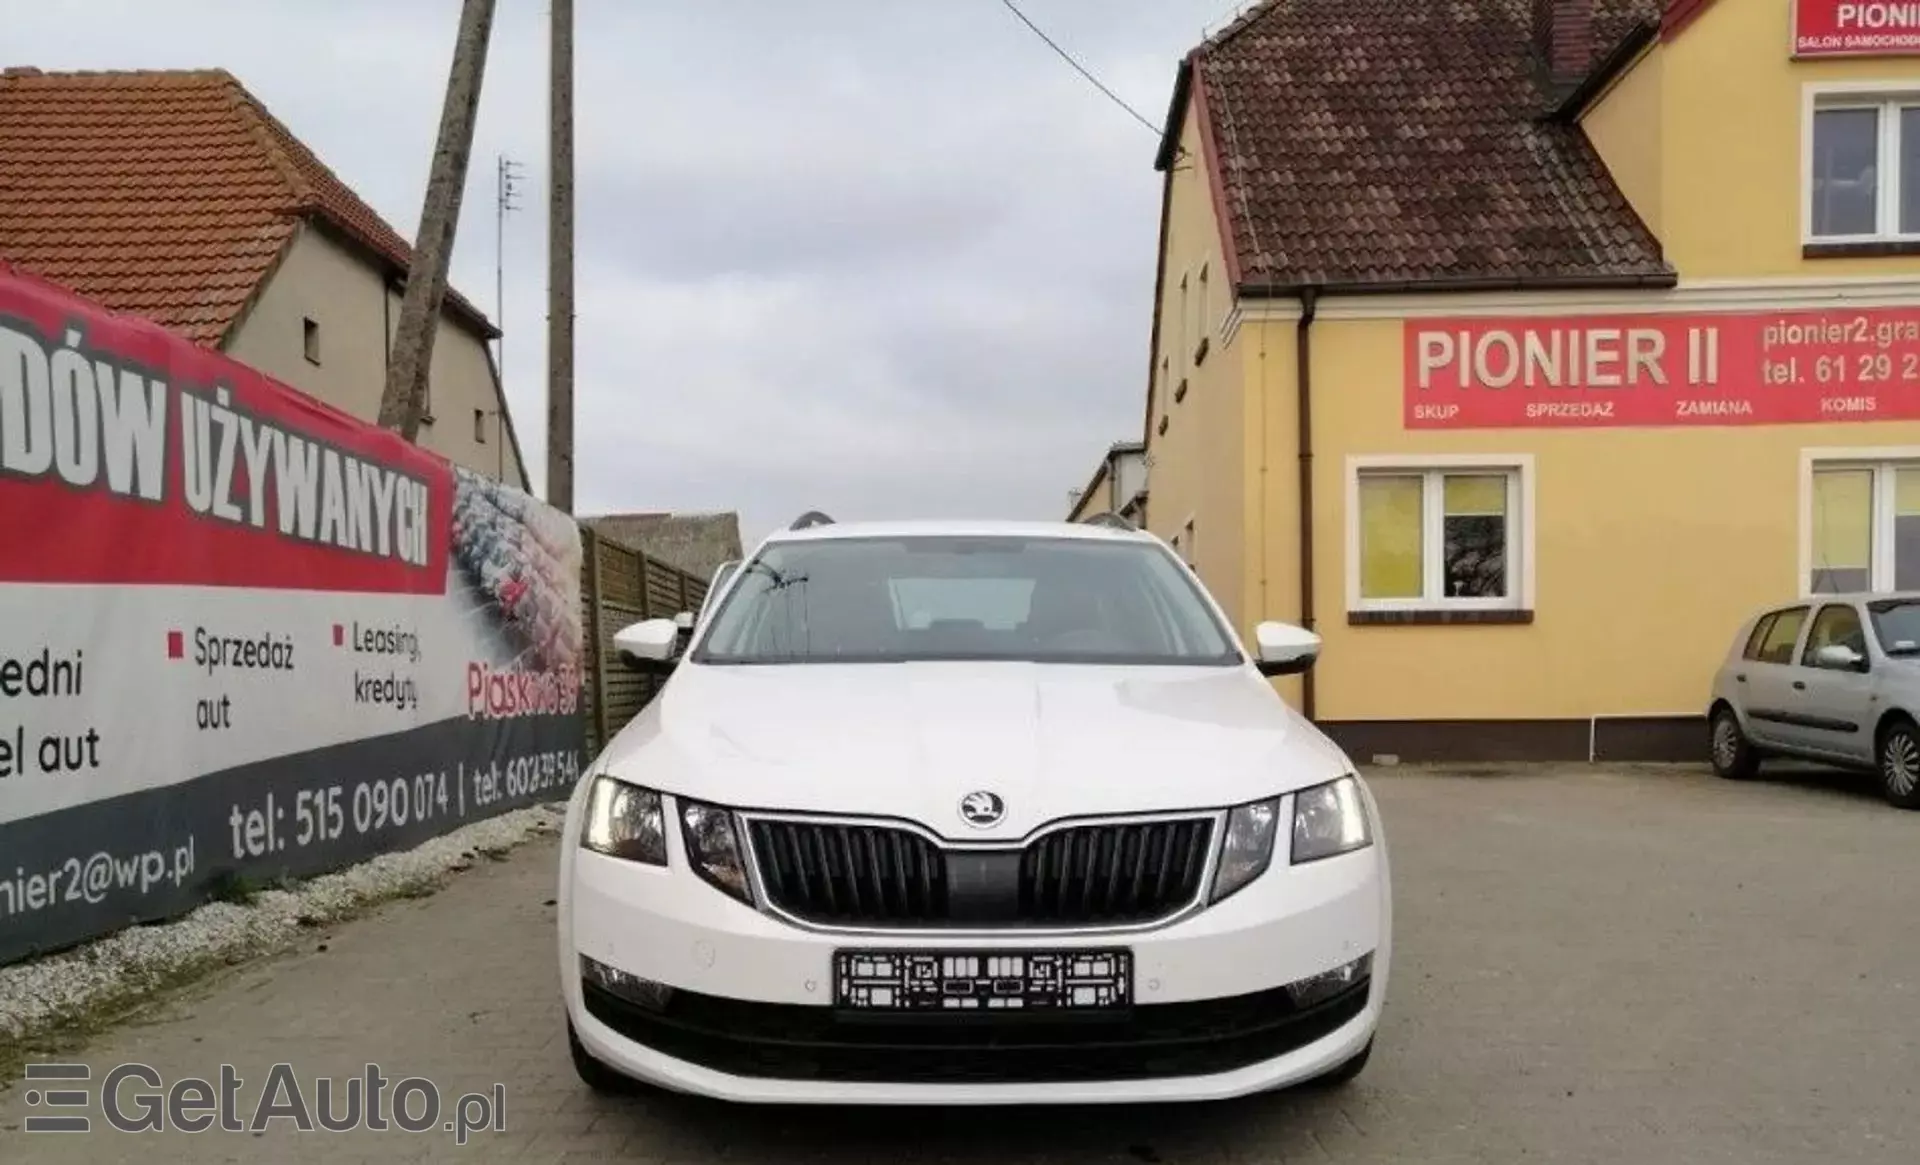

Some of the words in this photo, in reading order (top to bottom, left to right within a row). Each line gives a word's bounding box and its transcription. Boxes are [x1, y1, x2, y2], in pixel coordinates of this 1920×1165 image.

[1837, 3, 1920, 28] PIONI
[1798, 35, 1842, 48] SALON
[1763, 315, 1920, 352] pionier2.gra
[1418, 328, 1669, 389] PIONIER
[1688, 326, 1719, 385] II
[1762, 355, 1805, 385] tel.
[1815, 354, 1846, 383] 61
[1857, 353, 1892, 382] 29
[1901, 352, 1919, 380] 2
[1414, 404, 1460, 419] SKUP
[1676, 400, 1753, 416] ZAMIANA
[1820, 396, 1877, 412] KOMIS
[0, 326, 167, 501] DÓW
[181, 385, 428, 566] UŻYWANYCH
[194, 627, 294, 672] Sprzedaż
[0, 646, 82, 697] edni
[197, 695, 231, 731] aut
[38, 726, 100, 773] aut
[229, 791, 285, 860] tel:
[296, 785, 344, 846] 515
[353, 770, 409, 833] 090
[413, 771, 449, 822] 074
